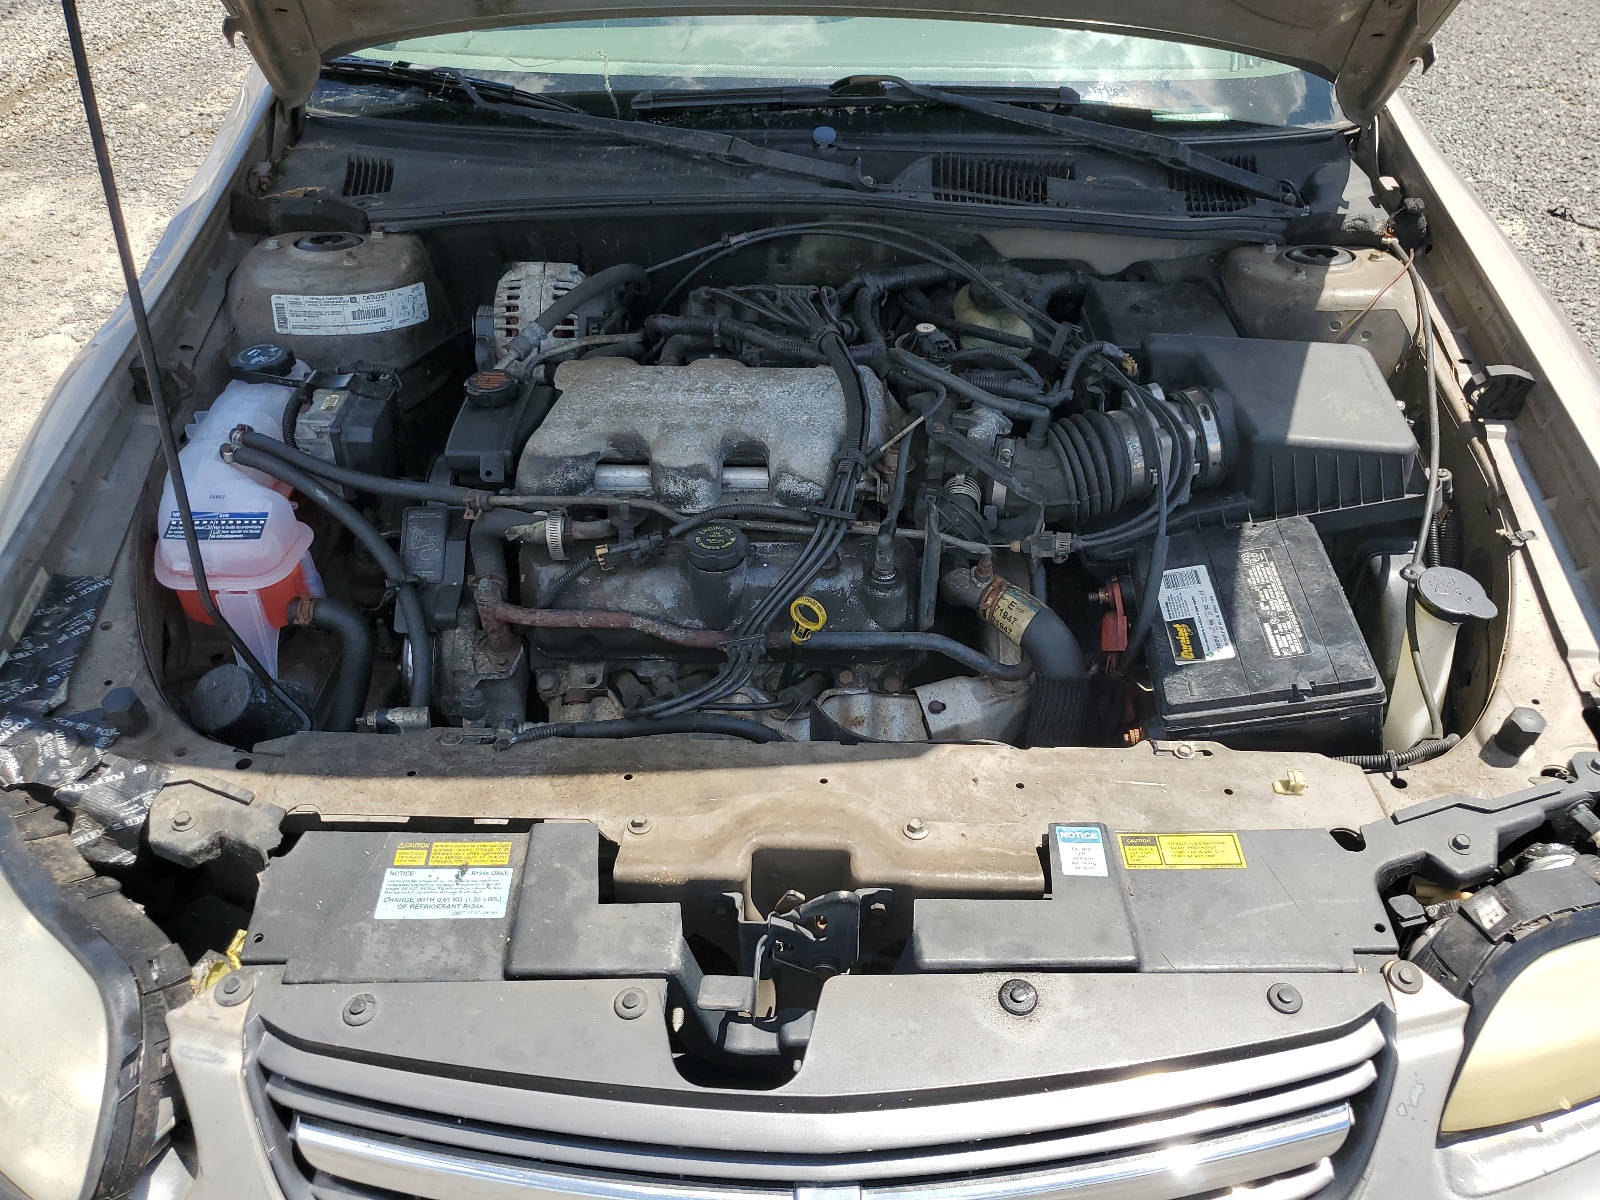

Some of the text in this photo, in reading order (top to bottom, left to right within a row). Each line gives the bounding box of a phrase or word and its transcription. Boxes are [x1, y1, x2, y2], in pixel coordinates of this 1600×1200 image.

[362, 293, 387, 301] CATALYST
[1007, 600, 1018, 611] E
[993, 604, 1018, 625] 71947
[1060, 831, 1098, 840] NOTICE
